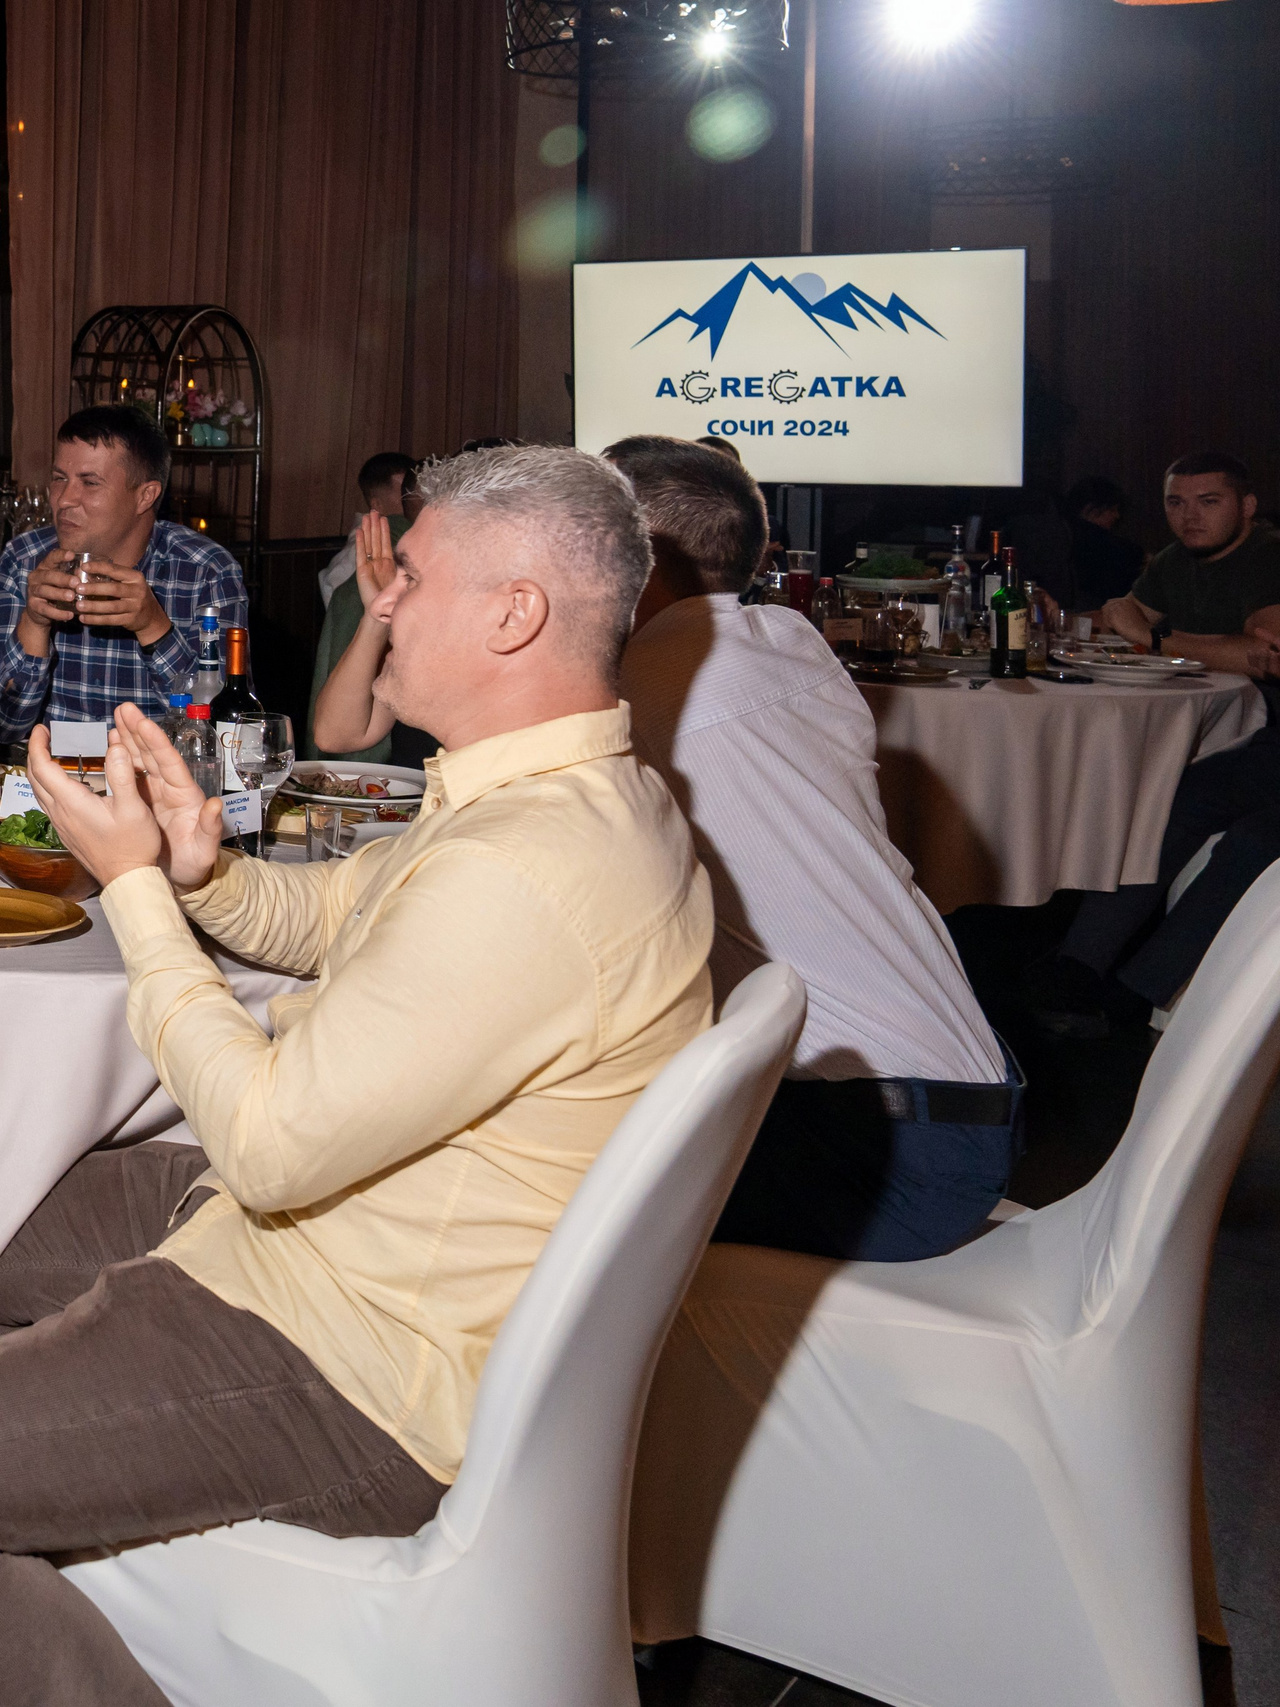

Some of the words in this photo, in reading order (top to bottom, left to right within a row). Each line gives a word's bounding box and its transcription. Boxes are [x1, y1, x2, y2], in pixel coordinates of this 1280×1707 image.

[655, 369, 906, 405] AGREGATKA
[707, 419, 774, 436] СОЧИ
[783, 420, 850, 436] 2024
[225, 796, 250, 806] МАКСИМ
